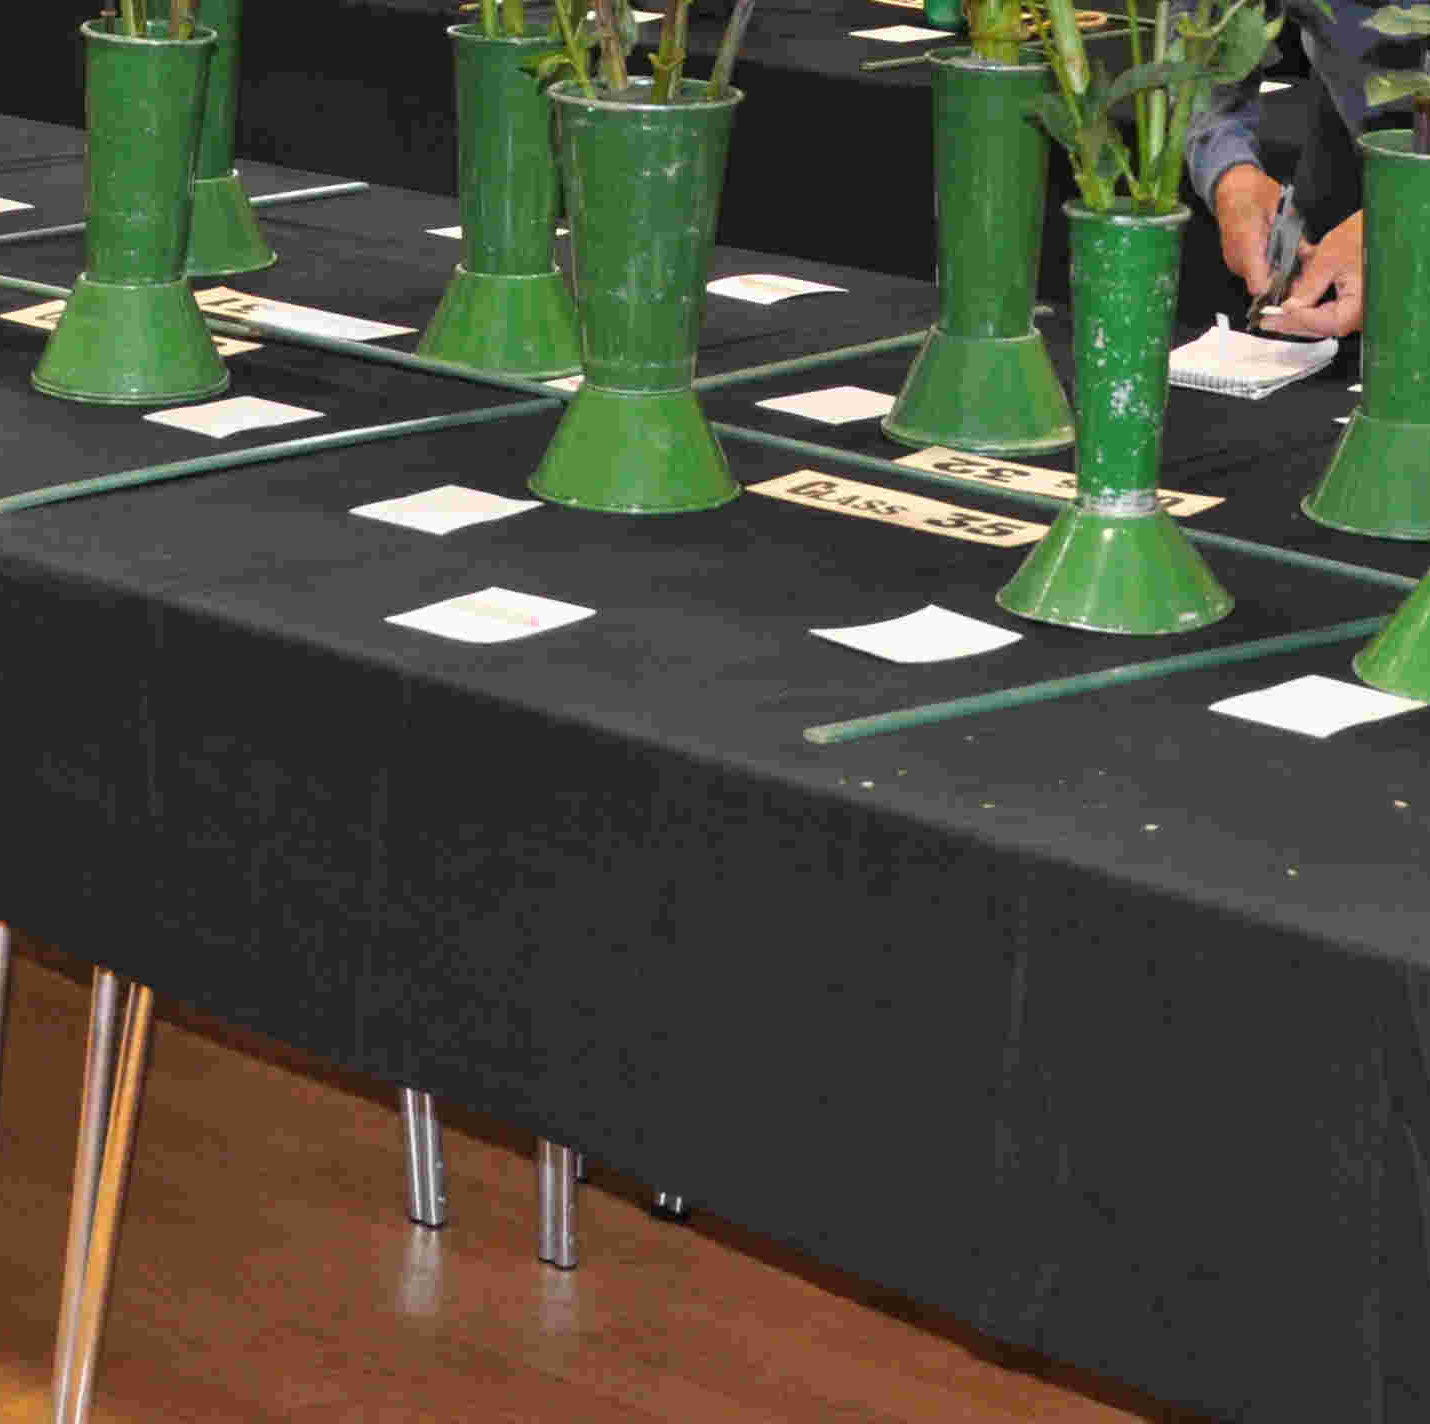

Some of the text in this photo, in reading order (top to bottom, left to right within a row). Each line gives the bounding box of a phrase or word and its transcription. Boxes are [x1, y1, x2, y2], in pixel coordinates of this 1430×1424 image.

[932, 456, 1032, 484] 32
[786, 480, 1028, 537] CLASS 35
